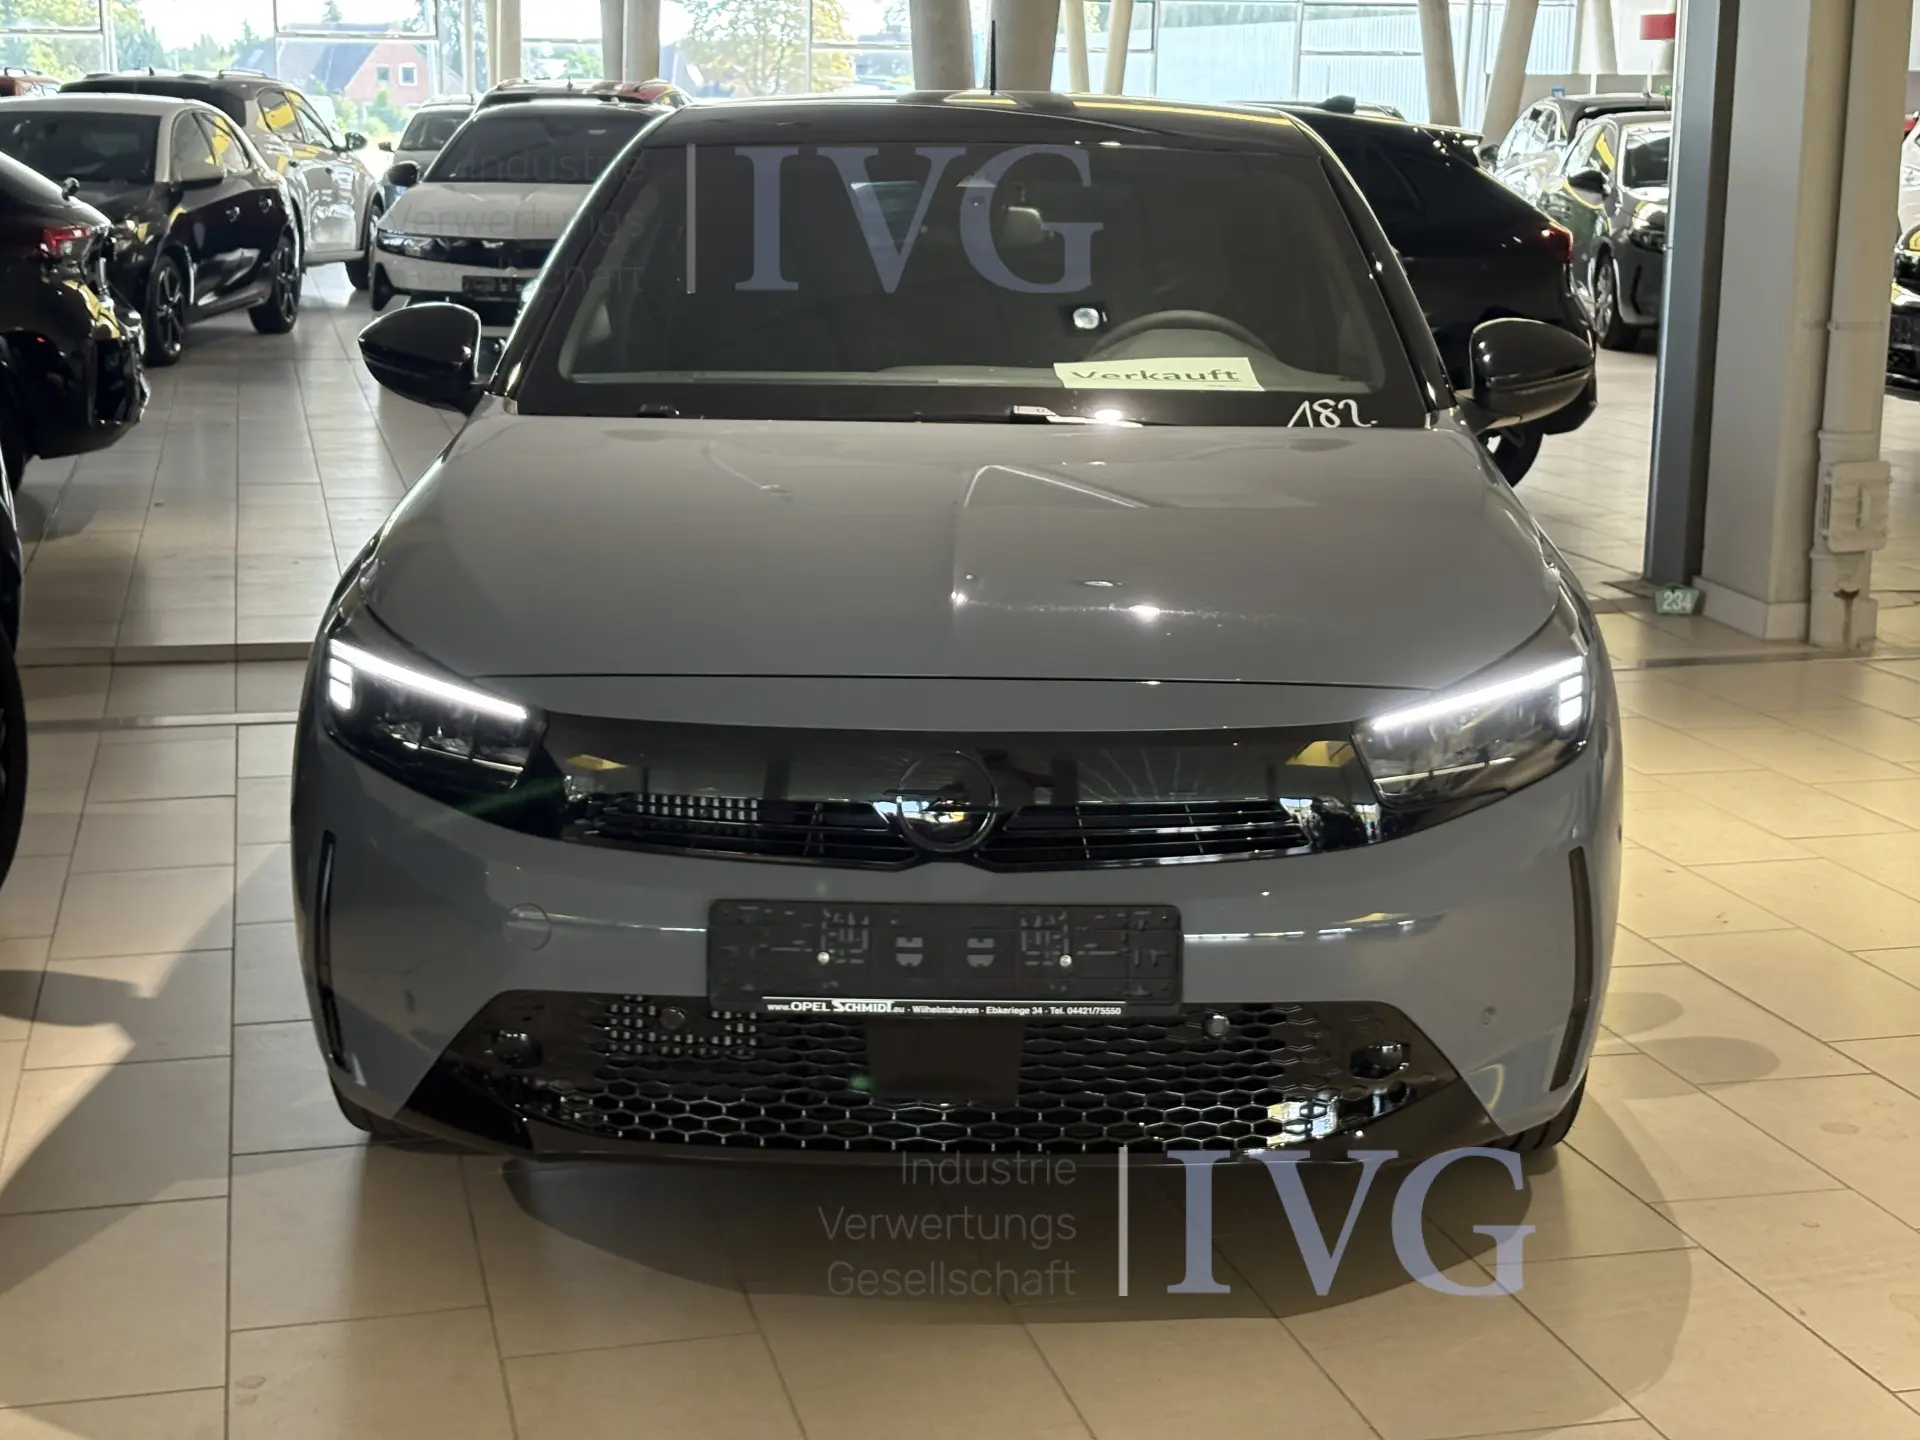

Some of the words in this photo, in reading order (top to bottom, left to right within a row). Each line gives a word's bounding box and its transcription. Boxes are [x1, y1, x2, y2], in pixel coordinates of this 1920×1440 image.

[1071, 368, 1239, 382] Verkauft
[1662, 591, 1693, 613] 234
[912, 1005, 980, 1014] Wilhelmshaven
[986, 1006, 1030, 1015] Ebkeriege
[1031, 1006, 1043, 1015] 34
[1050, 1006, 1066, 1015] Tel.
[1067, 1006, 1122, 1015] 04421/75550
